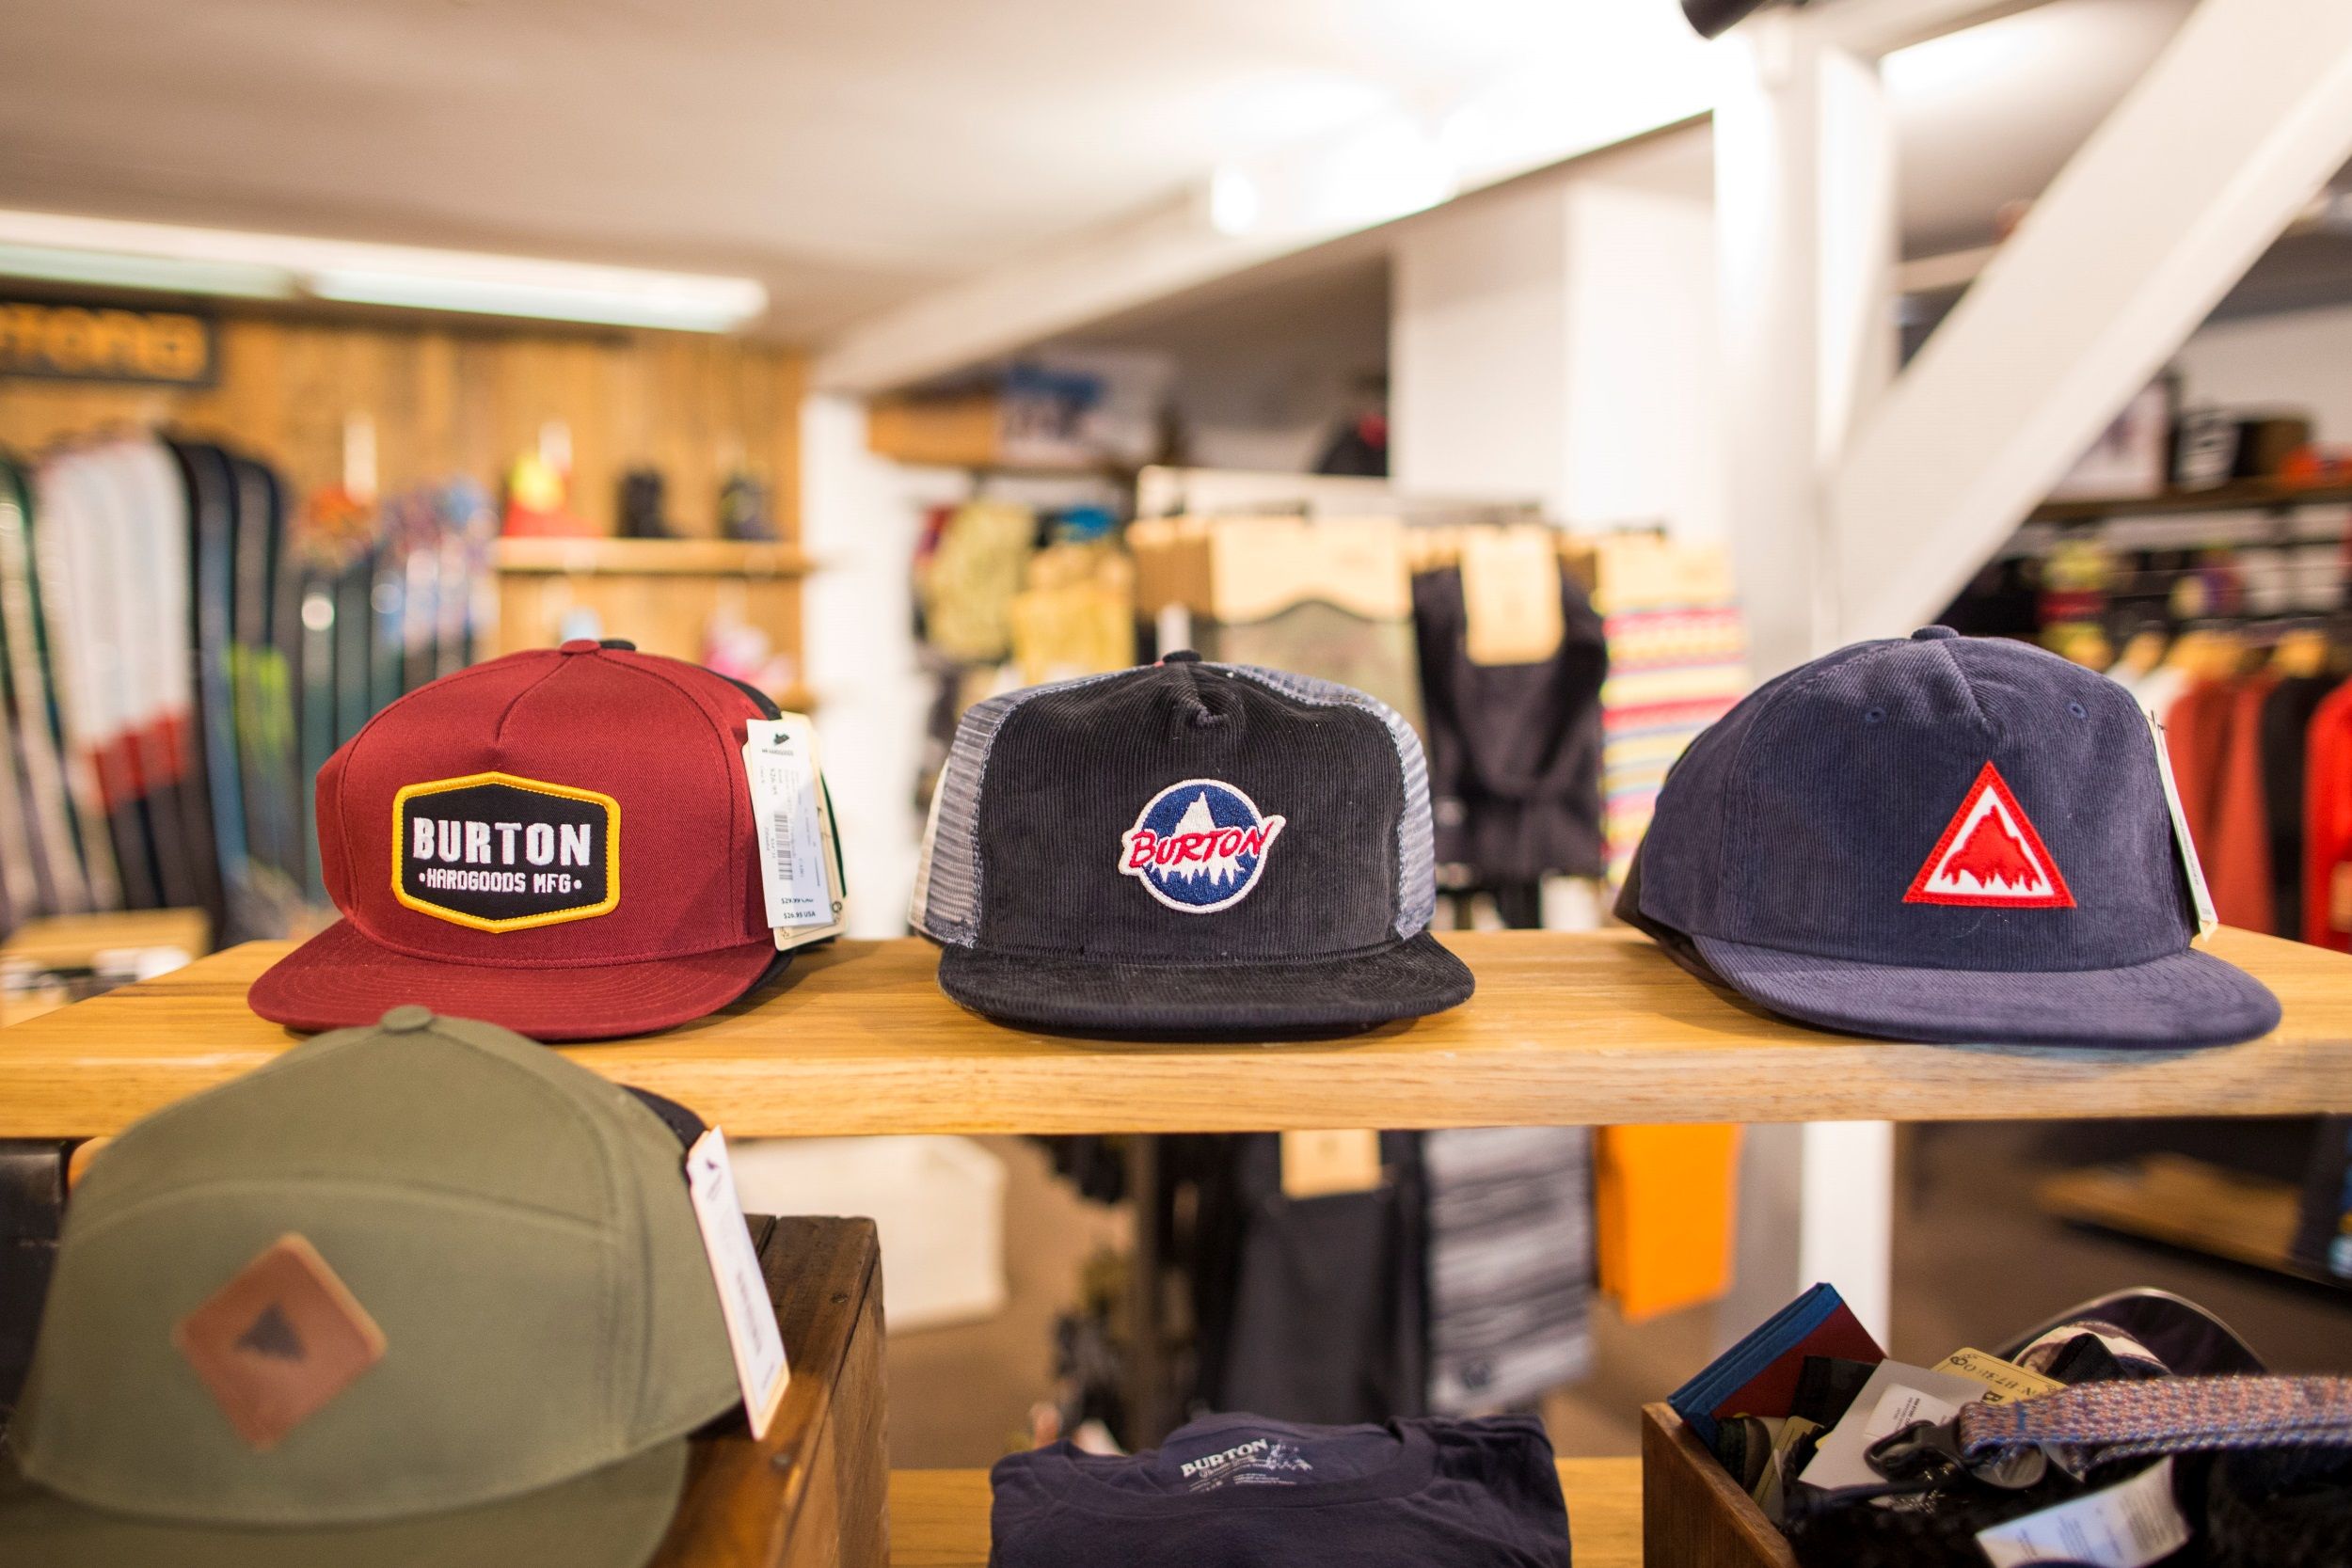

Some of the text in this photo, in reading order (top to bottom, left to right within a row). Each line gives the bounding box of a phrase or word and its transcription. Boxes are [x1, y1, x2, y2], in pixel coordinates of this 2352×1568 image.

[412, 816, 592, 866] BURTON
[1129, 820, 1276, 869] BURTON
[426, 867, 572, 894] HARDGOODS MFG
[1180, 1438, 1268, 1478] BURTON
